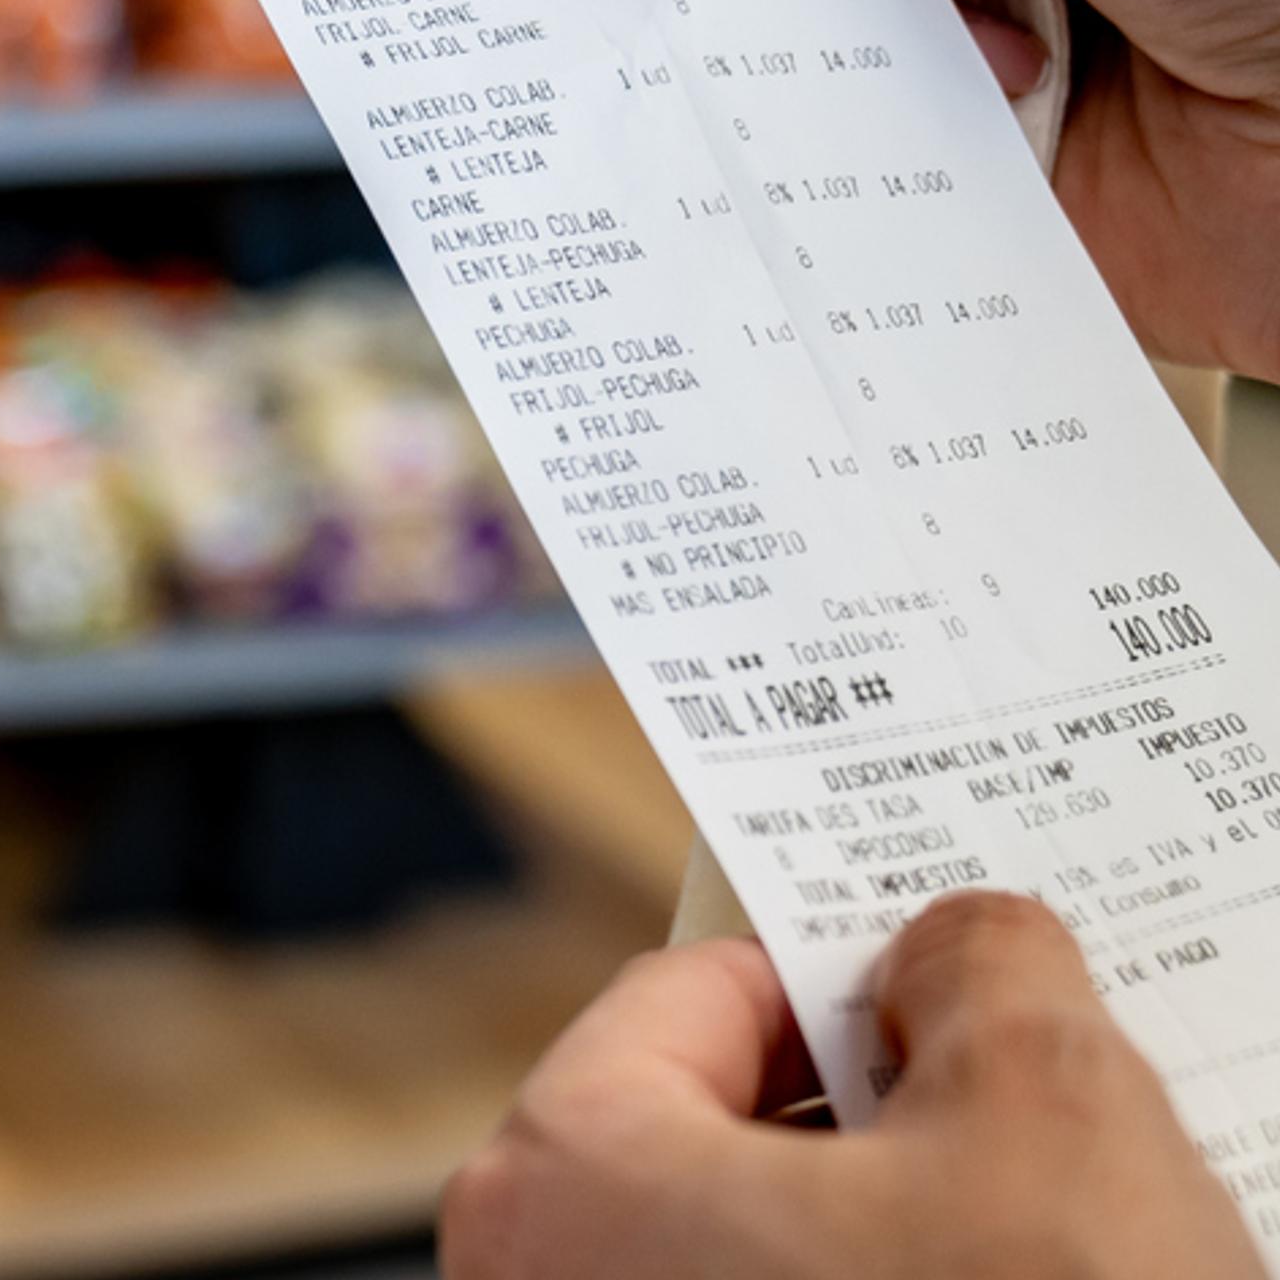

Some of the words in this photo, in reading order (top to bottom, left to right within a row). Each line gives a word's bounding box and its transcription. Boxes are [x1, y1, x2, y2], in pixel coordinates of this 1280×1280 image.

[314, 17, 402, 45] FRIJOL
[408, 2, 482, 31] CARNE
[385, 36, 469, 65] FRIJOL
[478, 20, 548, 48] CARNE
[366, 92, 478, 130] ALMUERZO
[485, 78, 567, 109] COLAB.
[617, 68, 632, 90] 1
[380, 112, 559, 160] LENTEJA-CARNE
[733, 118, 751, 141] 8
[451, 150, 549, 181] LENTEJA
[410, 191, 485, 221] CARNE
[430, 219, 539, 253] ALMUERZO
[546, 208, 629, 237] COLAB.
[676, 197, 692, 220] 1
[443, 240, 647, 286] LENTEJA-PECHUGA
[513, 277, 613, 312] LENTEJA
[475, 318, 576, 351] PECHUGA
[495, 346, 605, 382] ALMUERZO
[612, 335, 695, 364] COLAB.
[742, 324, 757, 347] 1
[858, 377, 877, 402] 8
[579, 409, 665, 441] FRIJOL
[540, 449, 642, 482] PECHUGA
[561, 479, 670, 515] ALMUERZO
[677, 466, 760, 499] COLAB.
[807, 455, 823, 479] 1
[928, 434, 989, 463] 1.037
[1011, 418, 1089, 451] 14.000
[576, 502, 766, 550] FRIJOL-PECHUGA
[644, 552, 678, 577] NO
[684, 530, 808, 571] PRINCIPIO
[609, 590, 655, 617] MAS
[661, 574, 772, 612] ENSALADA
[981, 574, 1002, 597] 9
[646, 656, 715, 685] TOTAL
[940, 615, 970, 642] 10
[1088, 571, 1183, 611] 140.000
[665, 694, 747, 739] TOTAL
[744, 689, 773, 732] A
[765, 675, 849, 730] PAGAR
[1109, 603, 1214, 662] 140.000
[820, 737, 1009, 793] DISCRIMINACION
[1013, 724, 1049, 755] DE
[1054, 699, 1176, 745] IMPUESTOS
[1183, 742, 1267, 783] 10.370
[732, 808, 813, 836] TARIFA
[865, 794, 924, 822] TASA
[966, 758, 1075, 803] BASE/IMP
[1137, 712, 1248, 760] IMPUESTO
[1108, 856, 1140, 879] es
[1146, 838, 1194, 867] IVA
[1199, 833, 1217, 853] y
[1227, 818, 1258, 842] el
[794, 878, 857, 905] TOTAL
[866, 856, 988, 898] IMPUESTOS
[1100, 875, 1202, 917] Consumo
[1114, 959, 1149, 987] DE
[1154, 936, 1219, 972] PAGO
